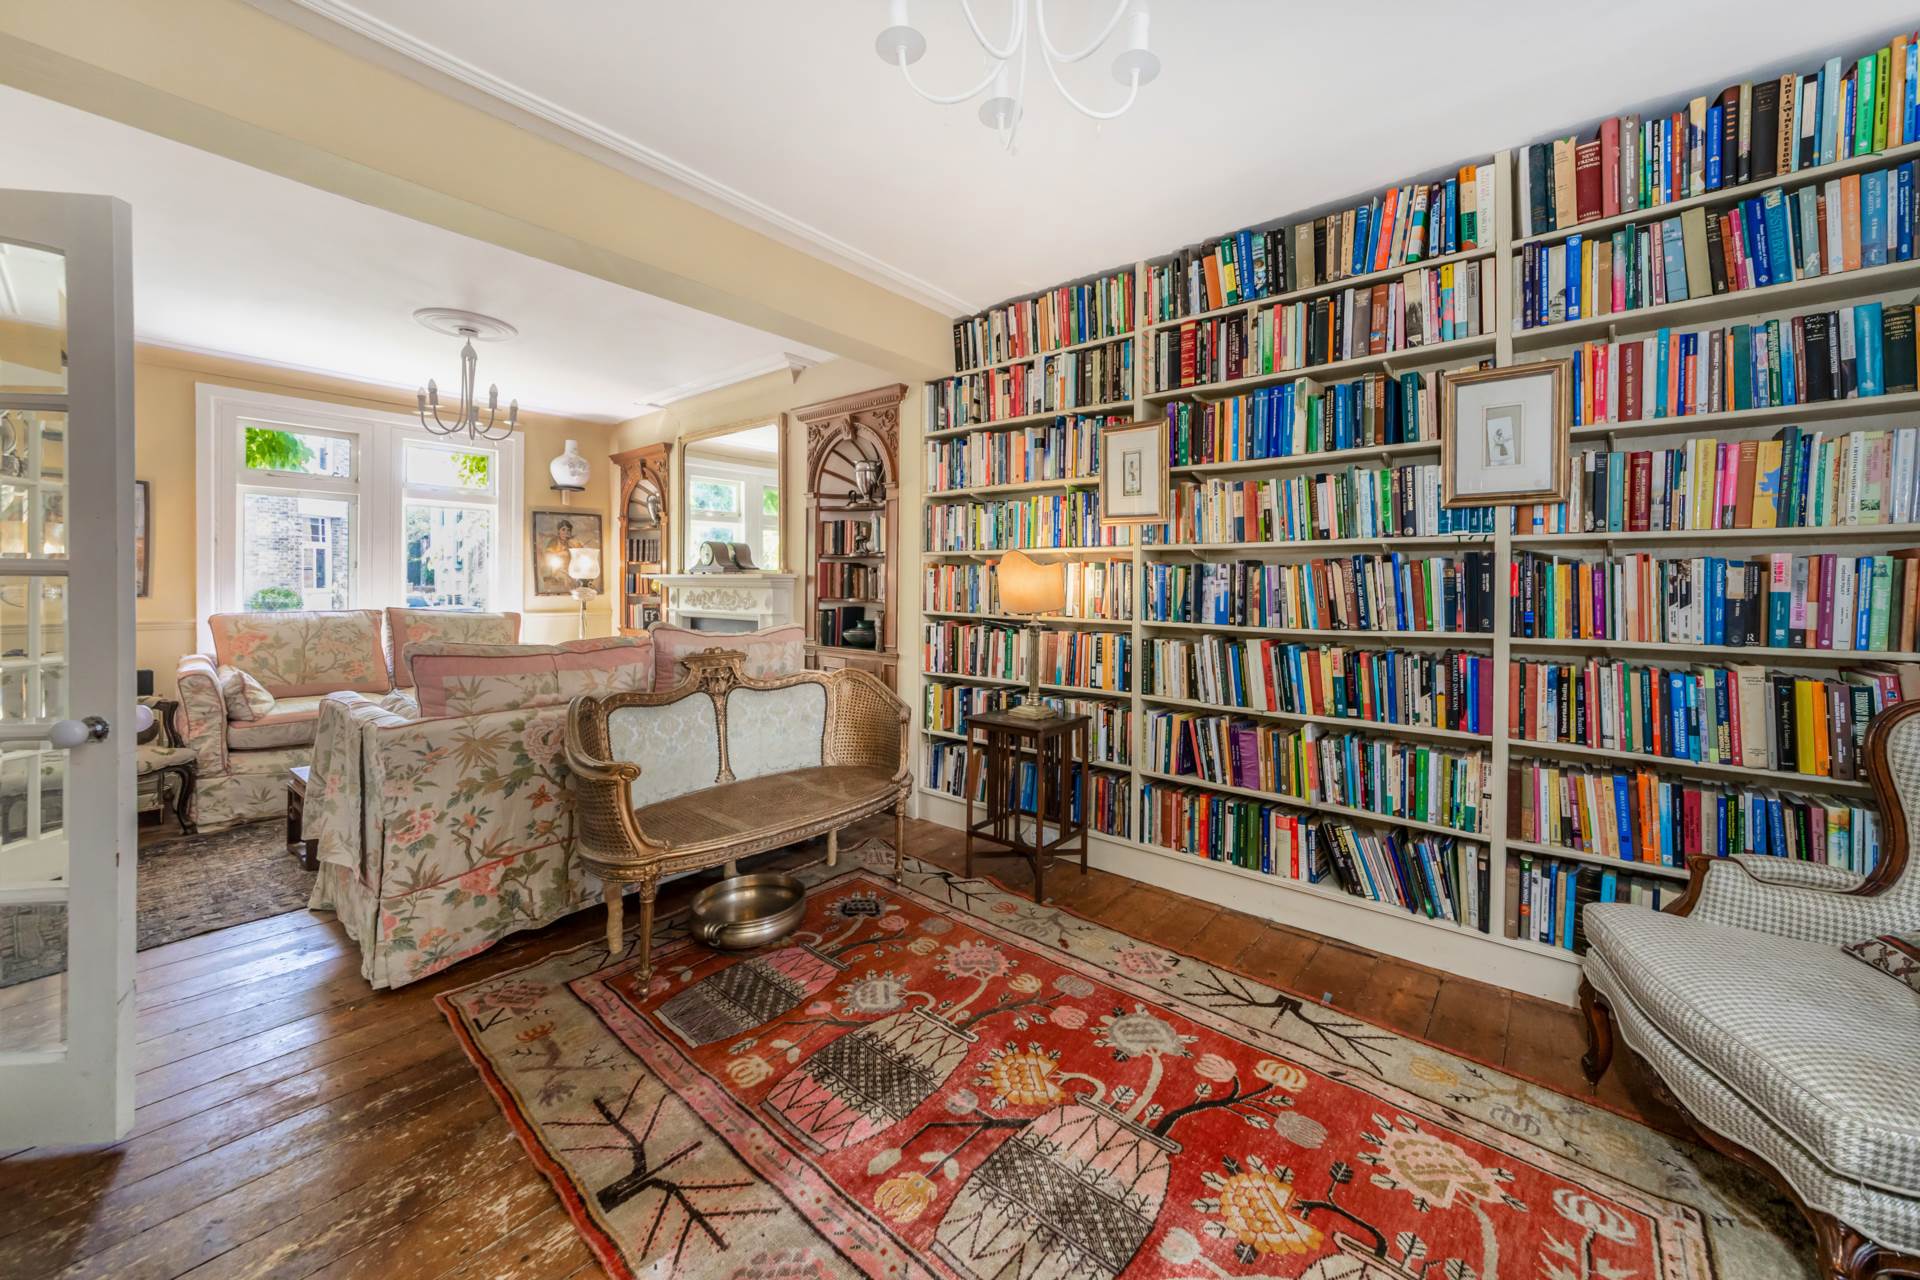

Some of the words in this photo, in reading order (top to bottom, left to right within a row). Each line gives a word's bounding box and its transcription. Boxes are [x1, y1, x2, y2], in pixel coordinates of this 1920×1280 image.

[1784, 78, 1793, 105] INDIA
[1783, 107, 1792, 130] WINS
[1578, 156, 1600, 167] FRENCH
[1782, 131, 1790, 169] FREEDOM
